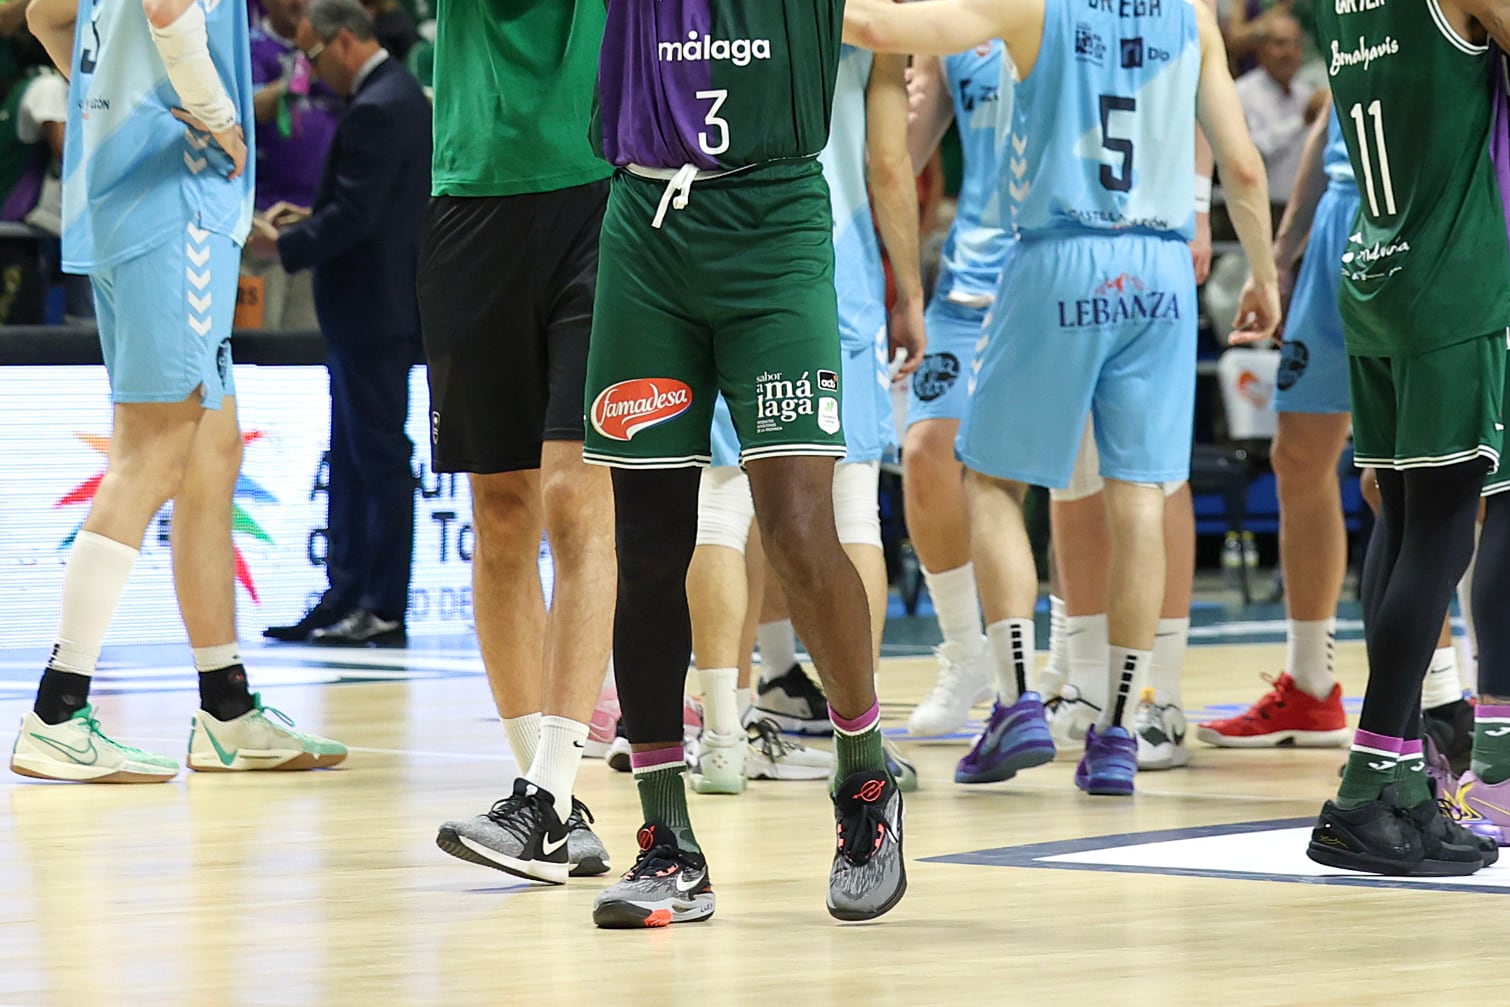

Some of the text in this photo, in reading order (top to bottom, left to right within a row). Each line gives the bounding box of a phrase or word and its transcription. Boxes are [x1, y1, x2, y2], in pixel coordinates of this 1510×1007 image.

[695, 88, 731, 156] 3
[1099, 94, 1137, 193] 5
[1349, 99, 1398, 218] 11
[1058, 291, 1180, 328] LEBANZA
[598, 382, 689, 427] famadesa
[755, 371, 782, 383] sabor
